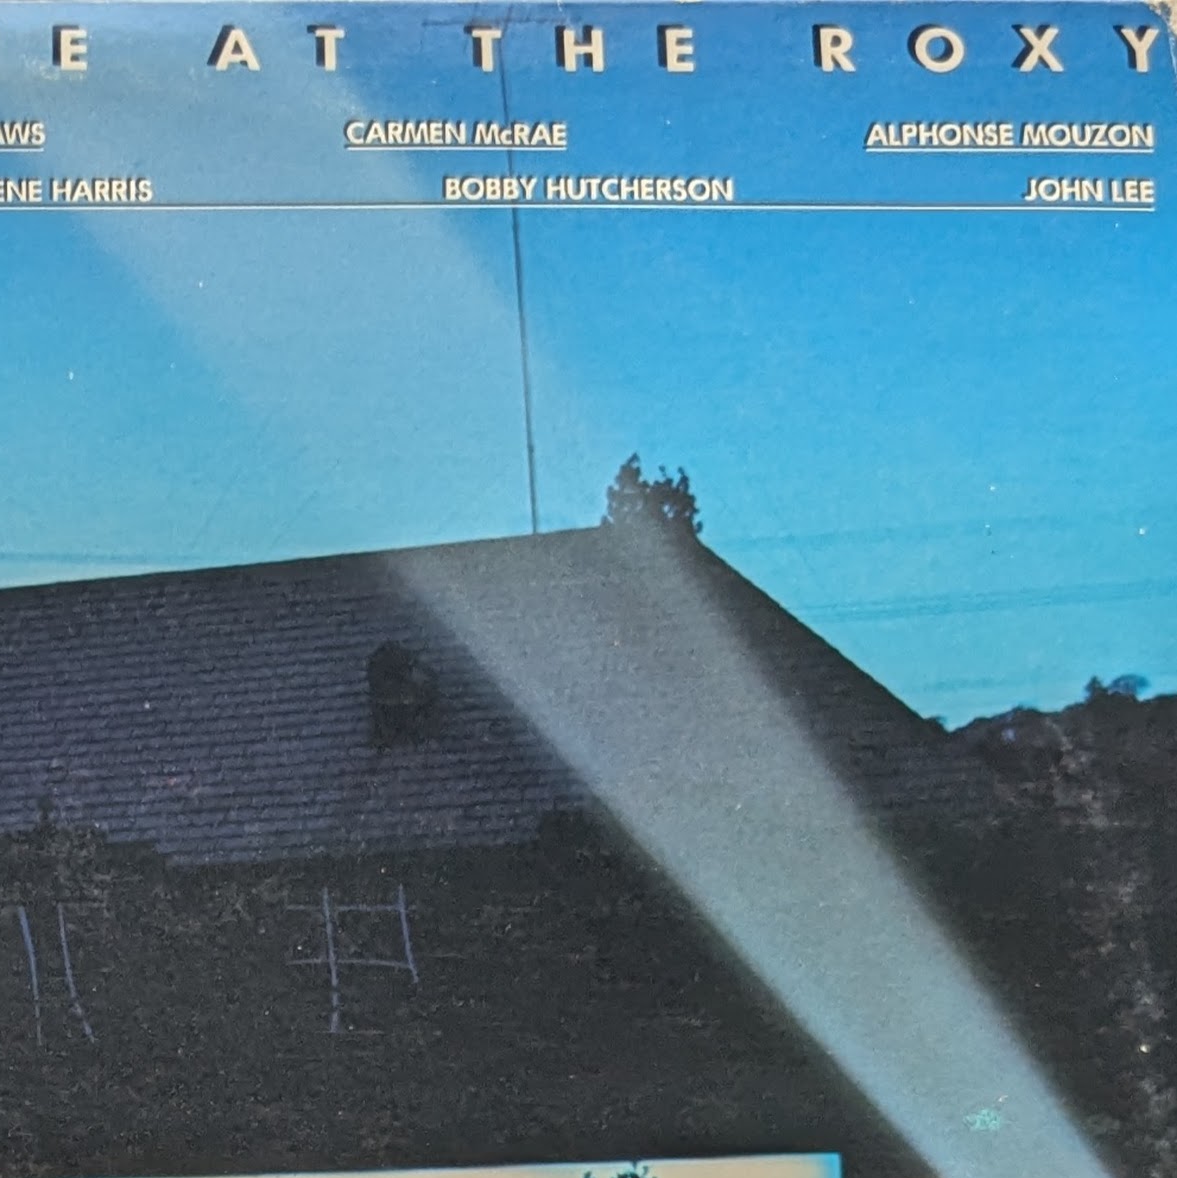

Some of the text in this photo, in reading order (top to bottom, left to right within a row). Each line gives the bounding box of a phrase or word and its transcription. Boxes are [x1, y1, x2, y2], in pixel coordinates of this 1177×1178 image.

[209, 24, 345, 72] AT
[466, 24, 695, 73] THE
[812, 24, 1159, 73] ROXY
[345, 120, 567, 147] CARMEN McRAE
[865, 122, 1154, 147] ALPHONSE MOUZON
[52, 179, 154, 203] HARRIS
[443, 176, 734, 202] BOBBY HUTCHERSON
[1024, 178, 1155, 204] JOHN LEE
